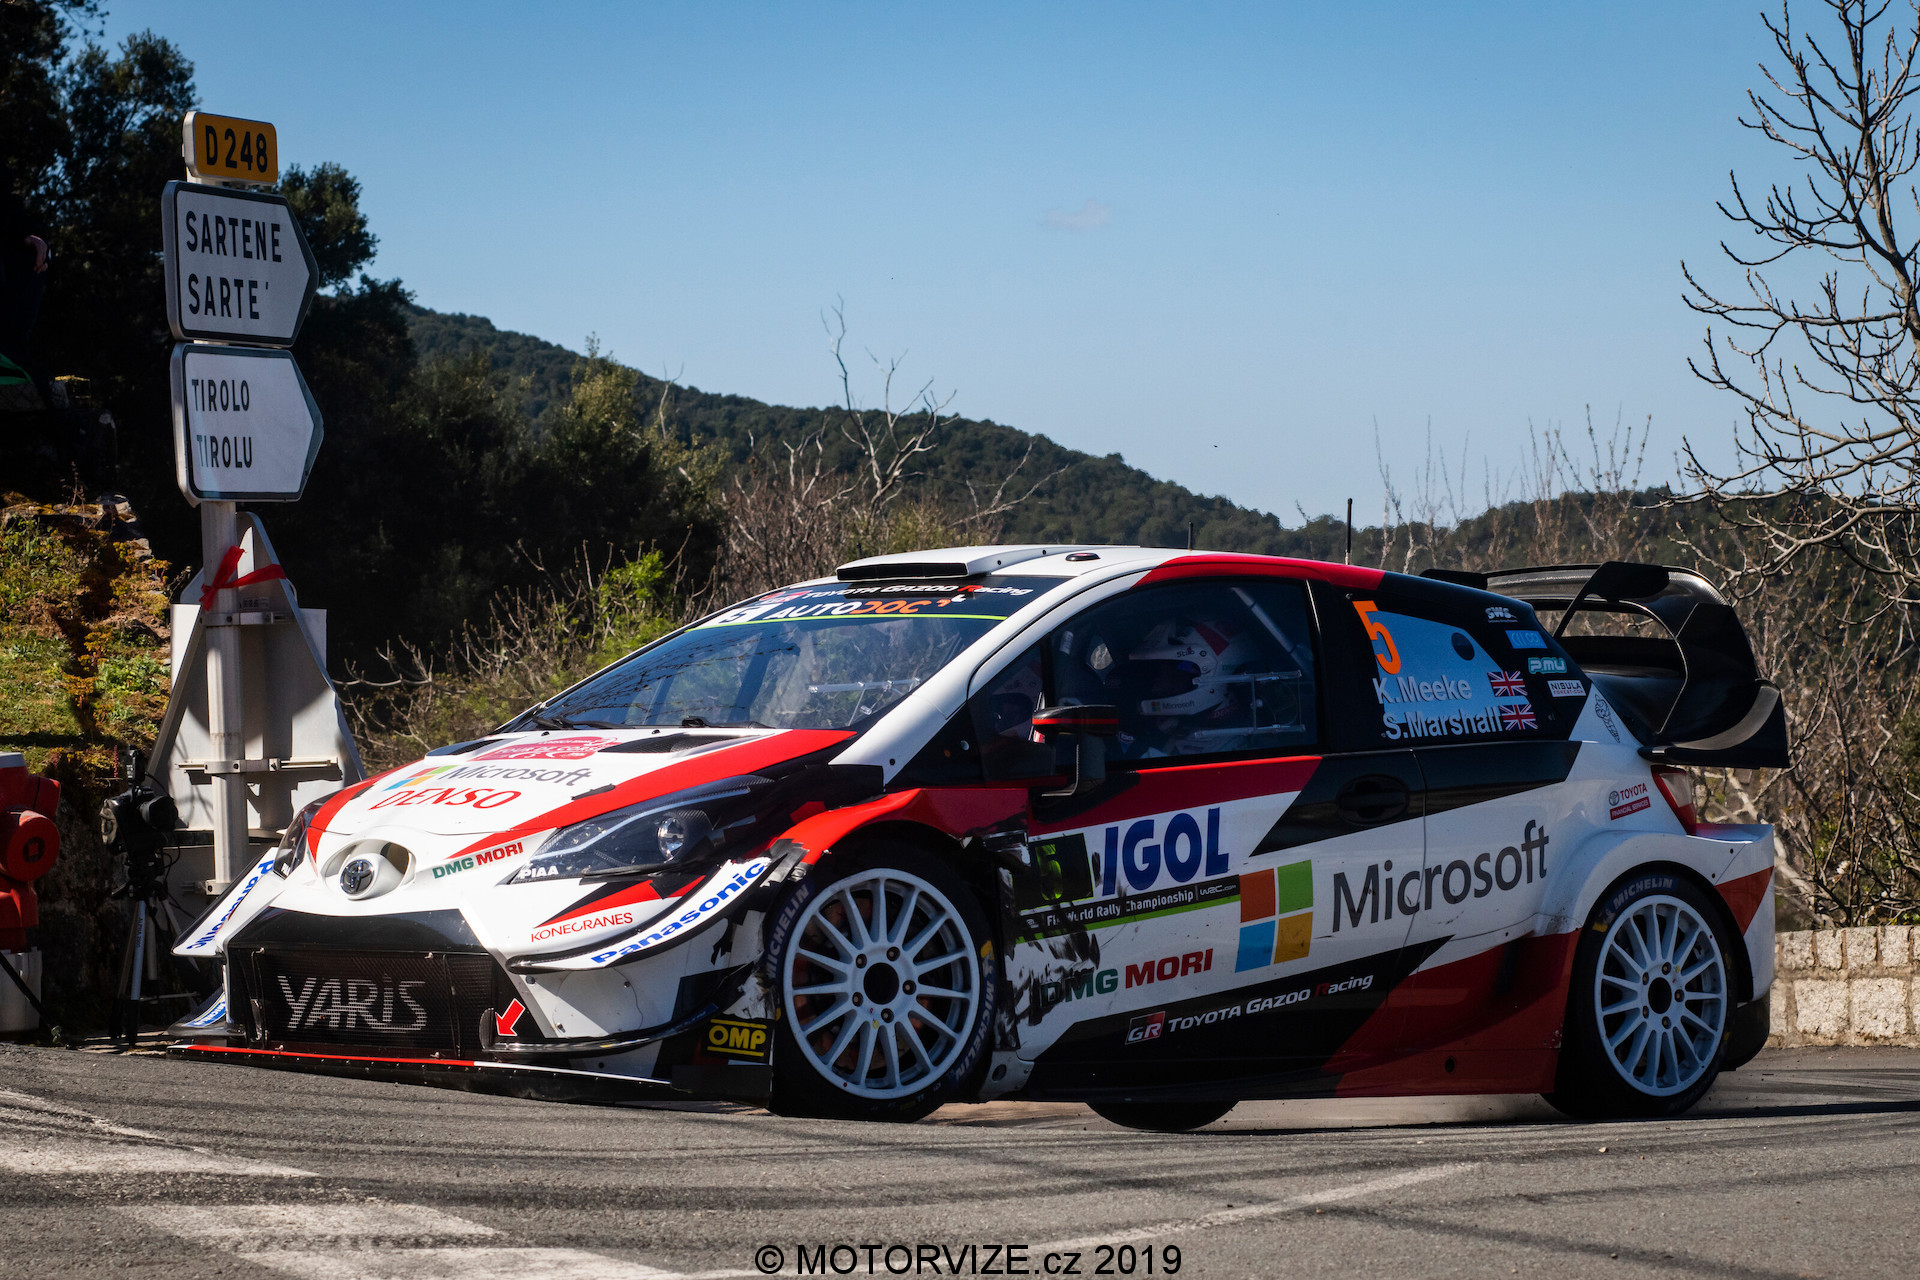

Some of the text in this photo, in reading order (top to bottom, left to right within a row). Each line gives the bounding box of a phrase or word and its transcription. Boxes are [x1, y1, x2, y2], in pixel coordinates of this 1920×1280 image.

[185, 210, 282, 263] SARTENE
[191, 379, 250, 412] TIROLO
[196, 434, 252, 468] TIROLU
[801, 586, 879, 599] TOYOTA
[880, 584, 959, 594] GAZOO
[957, 585, 1034, 597] Racing
[762, 600, 931, 620] AUTODOC
[1352, 600, 1401, 675] 5
[1162, 700, 1195, 710] Microsoft
[1372, 675, 1473, 704] K.Meeke
[1382, 705, 1504, 740] S.Marshall
[438, 765, 592, 786] Microsoft
[1620, 783, 1648, 801] TOYOTA
[367, 788, 522, 810] DENSO
[432, 841, 524, 879] DMG MORI
[1102, 807, 1229, 896] IGOL
[519, 865, 559, 880] PIAA
[1332, 819, 1549, 933] Microsoft
[1097, 903, 1121, 919] Rally
[1613, 877, 1673, 911] MICHELIN
[530, 912, 633, 943] KONECRANES
[590, 861, 766, 965] Panasonic
[765, 883, 811, 979] MICHELIN
[1125, 948, 1213, 989] MORI
[1127, 974, 1374, 1042] GR TOYOTA GAZOO Racing
[708, 1025, 767, 1050] OMP
[955, 980, 995, 1080] MICHELIN
